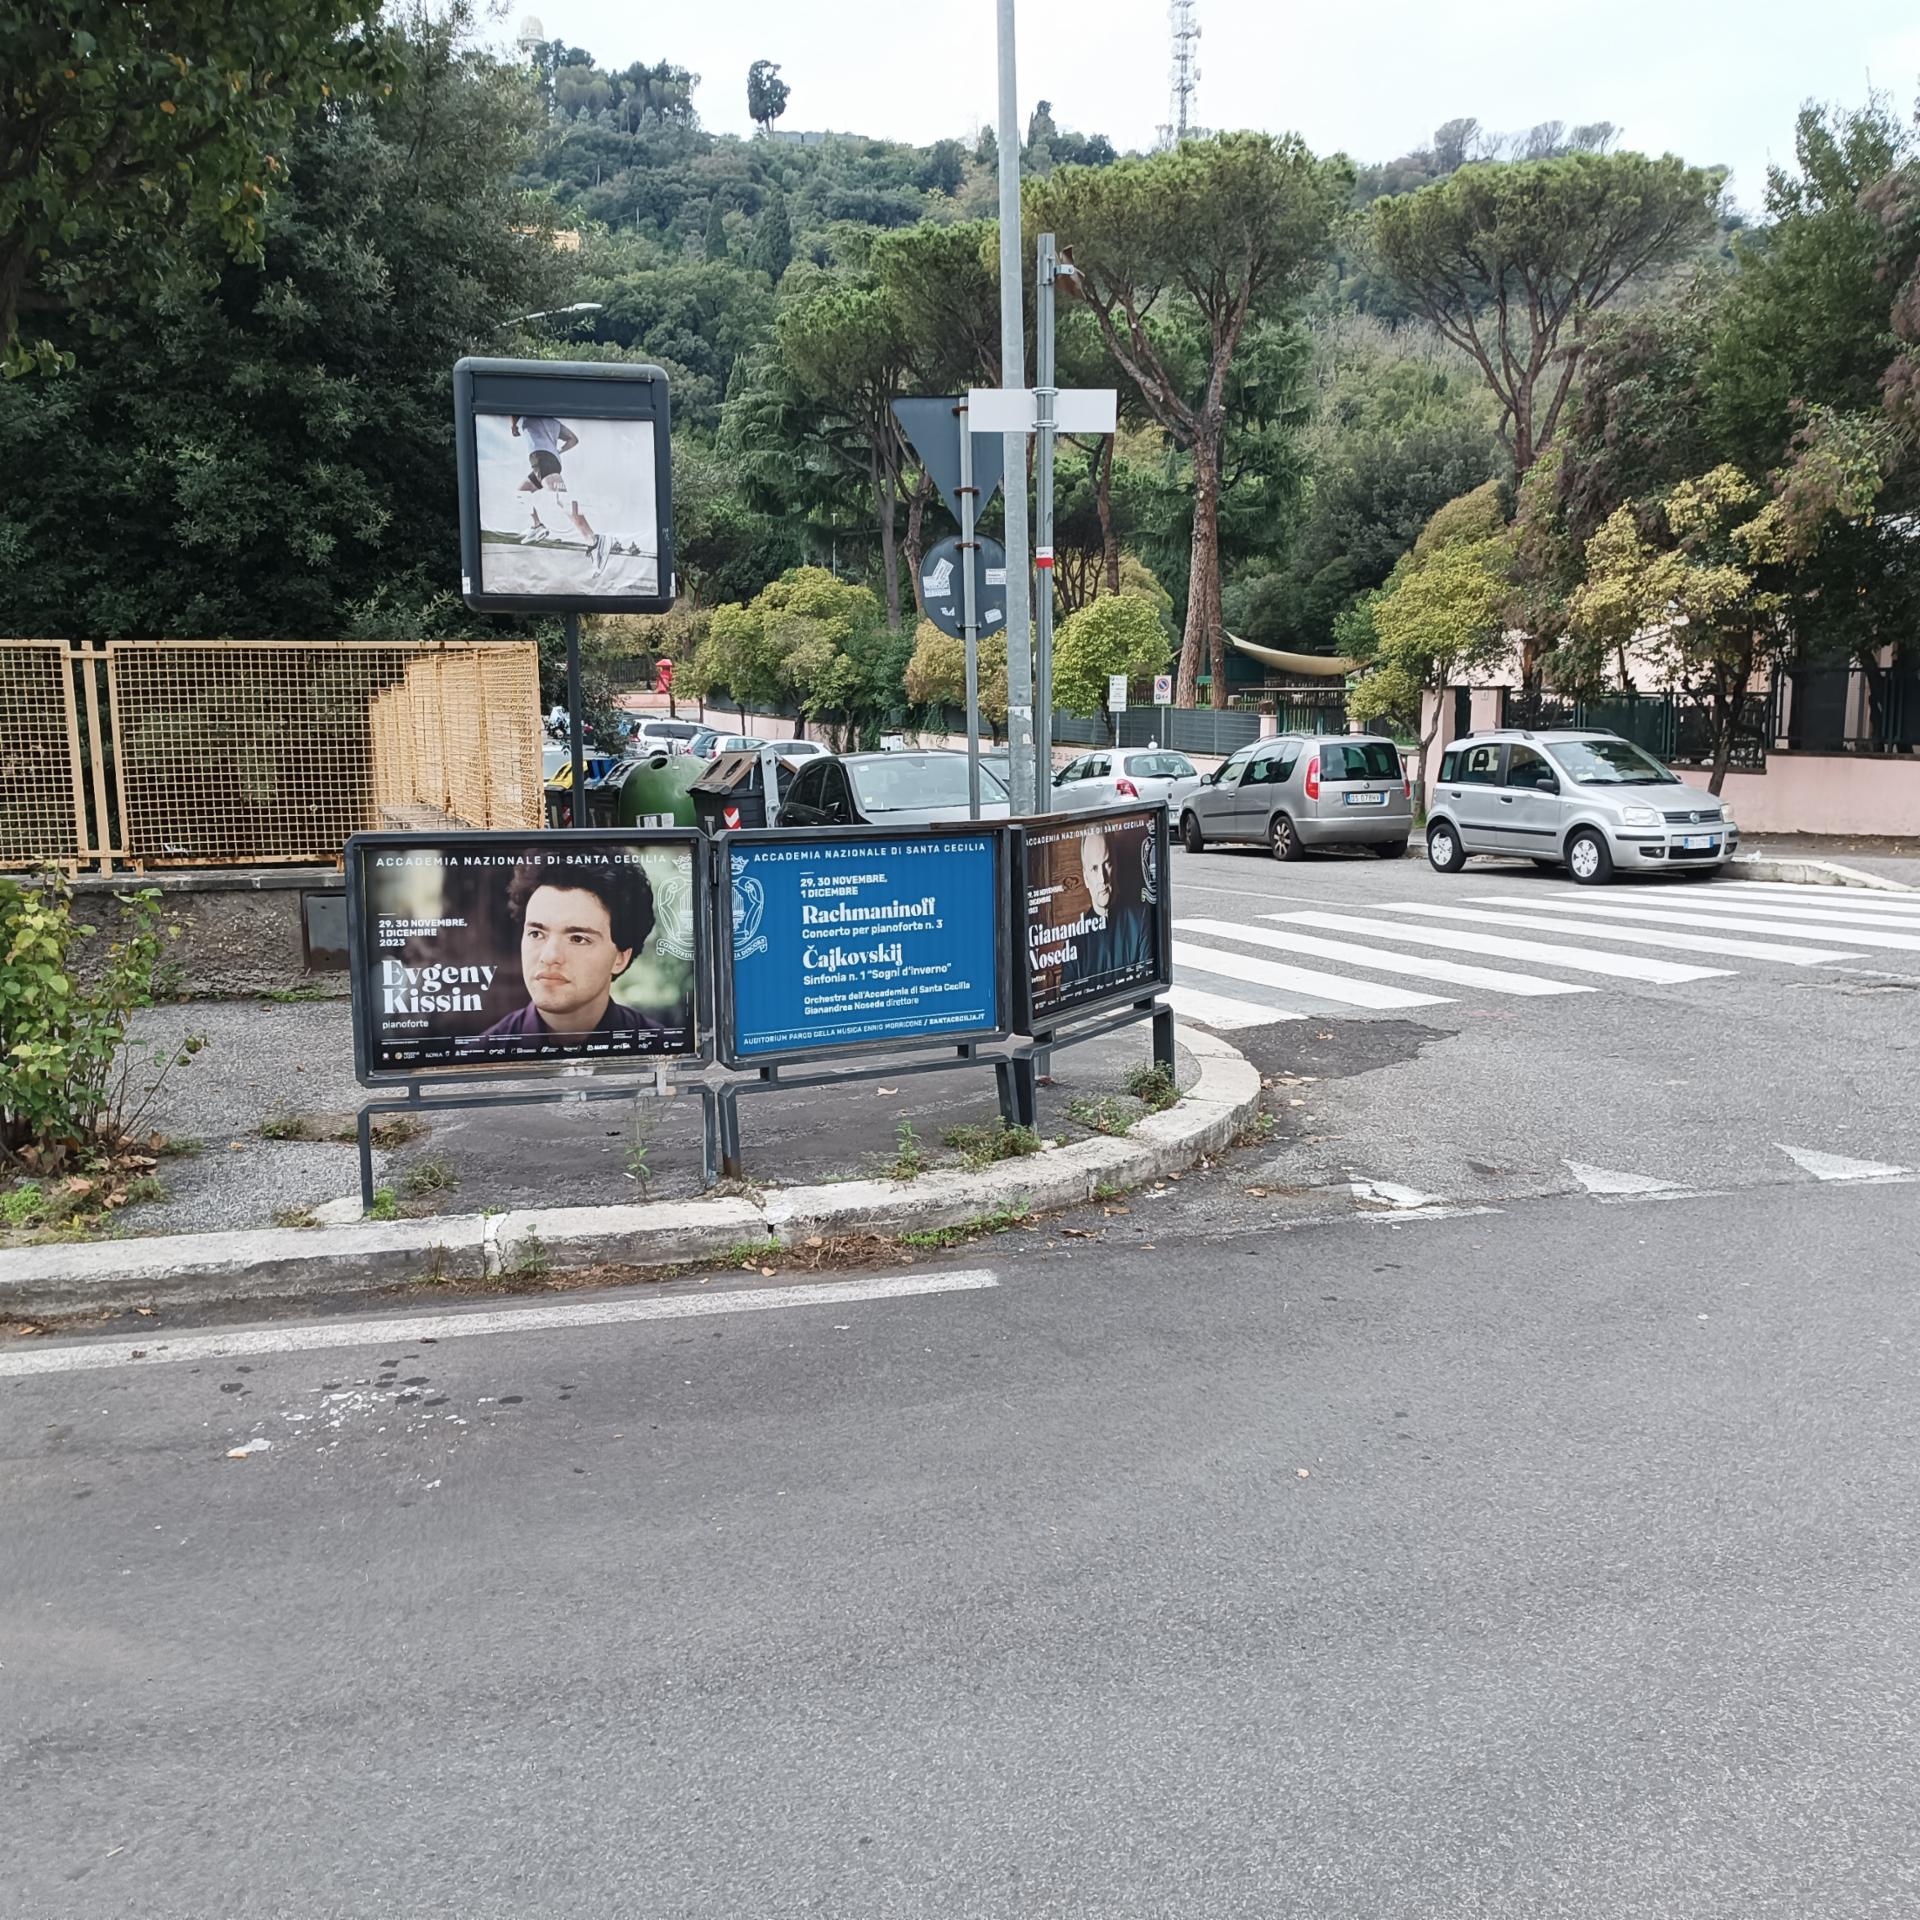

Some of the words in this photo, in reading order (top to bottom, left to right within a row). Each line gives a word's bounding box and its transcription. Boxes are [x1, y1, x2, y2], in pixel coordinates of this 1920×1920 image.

[1061, 826, 1095, 840] NAZIONALE
[1096, 826, 1103, 835] DI
[1104, 822, 1123, 833] SANTA
[1123, 819, 1145, 830] CECILIA
[376, 856, 459, 867] ACCADEMIA
[464, 855, 542, 866] NAZIONALE
[547, 855, 561, 865] DI
[566, 854, 609, 865] SANTA
[614, 854, 667, 864] CECILIA
[754, 851, 821, 862] ACCADEMIA
[825, 847, 887, 859] NAZIONALE
[891, 846, 902, 855] DI
[906, 844, 940, 855] SANTA
[943, 842, 985, 853] CECILIA
[800, 877, 816, 888] 29,
[817, 876, 831, 887] 30
[832, 873, 888, 885] NOVEMBRE,
[801, 890, 807, 898] 1
[808, 886, 859, 898] DICEMBRE
[802, 896, 936, 925] Rachmaninoff
[378, 919, 394, 928] 29,
[396, 919, 410, 928] 30
[410, 918, 468, 928] NOVEMBRE,
[379, 929, 385, 938] 1
[386, 928, 438, 937] DICEMBRE
[802, 925, 851, 939] Concerto
[852, 924, 870, 937] per
[871, 920, 924, 935] pianoforte
[925, 920, 935, 929] n.
[936, 919, 944, 929] 3
[1028, 911, 1107, 948] Gianandrea
[379, 938, 406, 947] 2023
[802, 943, 904, 973] Čajkovskij
[381, 959, 499, 992] Evgeny
[803, 970, 847, 986] Sinfonia
[848, 972, 858, 982] n.
[859, 970, 867, 981] 1
[382, 986, 484, 1014] Kissin
[804, 994, 847, 1005] Orchestra
[848, 987, 909, 1001] dell'Accademia
[910, 985, 918, 994] di
[919, 984, 943, 994] Santa
[944, 981, 971, 991] Cecilia
[804, 1003, 853, 1015] Gianandrea
[854, 1000, 885, 1010] Noseda
[885, 997, 920, 1007] direttore
[382, 1018, 430, 1030] pianoforte
[743, 1034, 788, 1045] AUDITORIUM
[789, 1031, 813, 1041] PARCO
[813, 1028, 836, 1038] DELLA
[836, 1025, 862, 1035] MUSICA
[863, 1023, 884, 1033] ENNIO
[884, 1019, 923, 1029] MORRICONE
[923, 1018, 928, 1027] /
[929, 1013, 986, 1025] SANTACECILIA.IT
